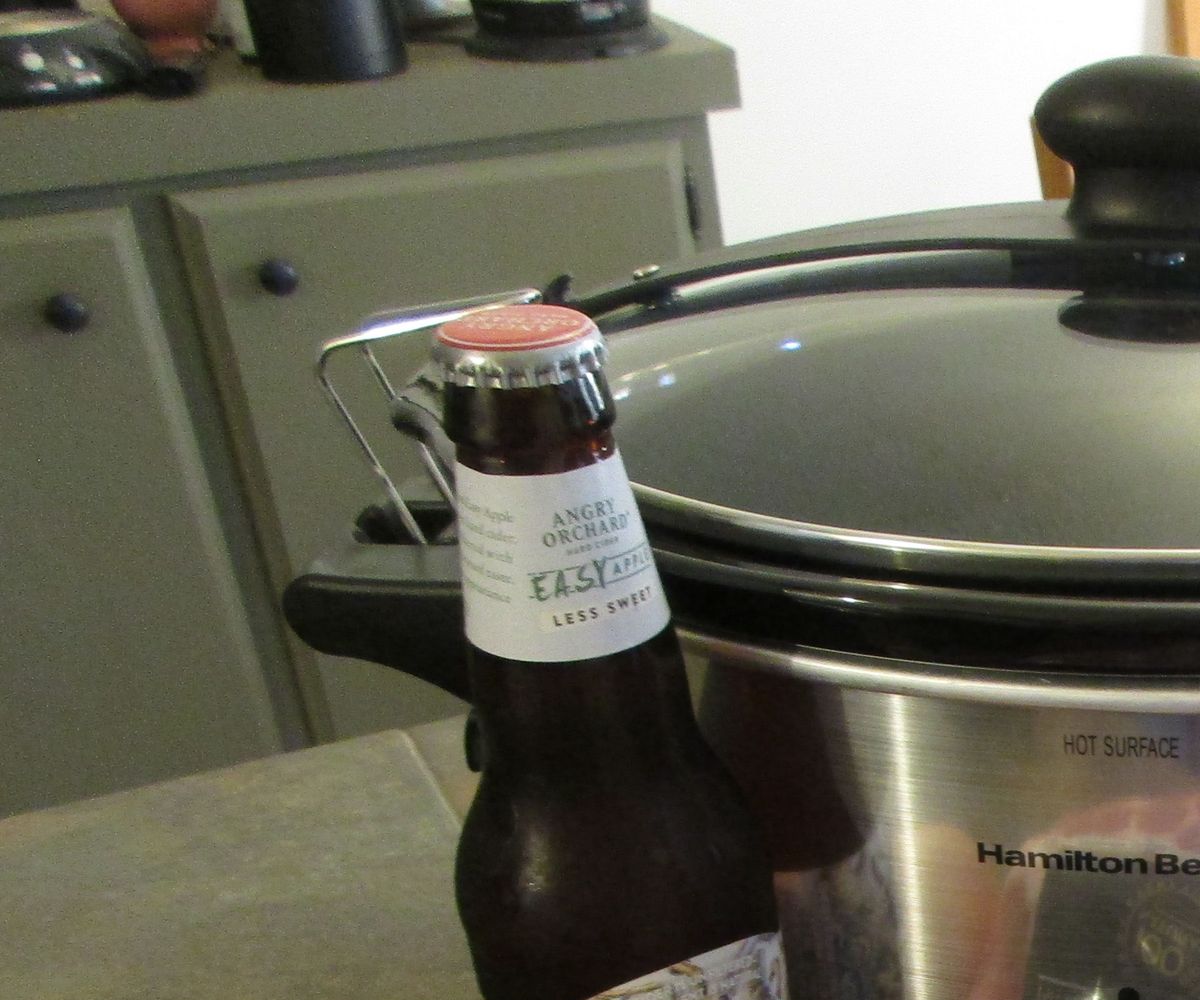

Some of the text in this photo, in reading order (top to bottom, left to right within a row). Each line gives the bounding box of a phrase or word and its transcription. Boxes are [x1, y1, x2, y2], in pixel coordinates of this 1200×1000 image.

[553, 499, 614, 528] ANGRY
[529, 556, 607, 602] EASY
[553, 586, 651, 627] LESS SWEET
[1062, 735, 1180, 759] HOT SURFACE
[976, 842, 1149, 875] Hamilton
